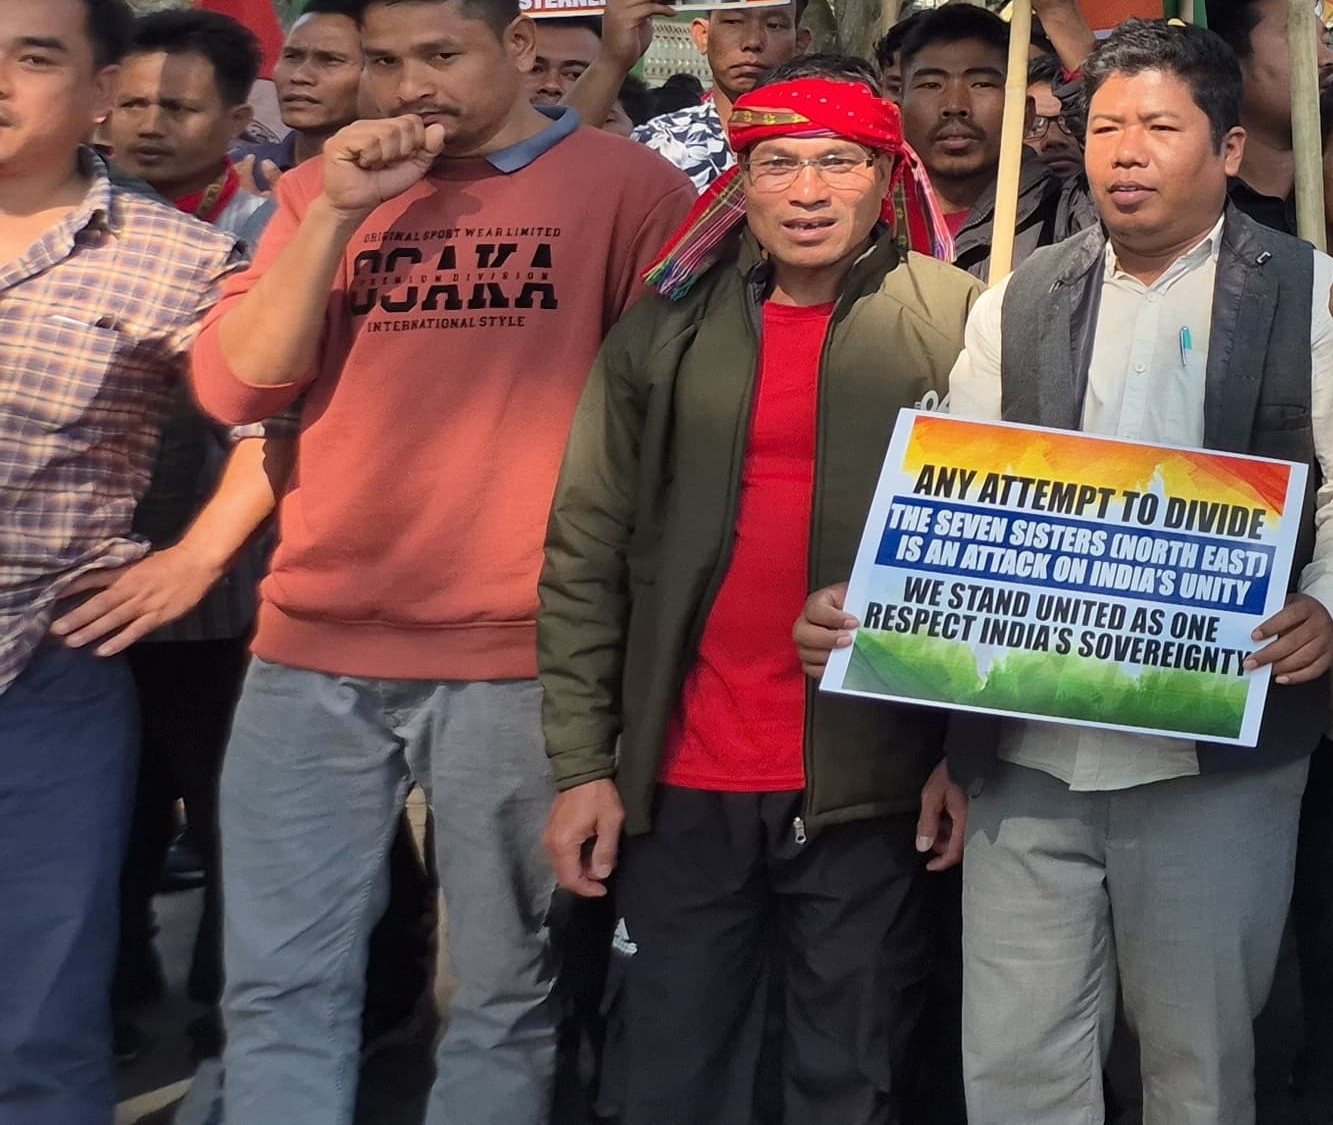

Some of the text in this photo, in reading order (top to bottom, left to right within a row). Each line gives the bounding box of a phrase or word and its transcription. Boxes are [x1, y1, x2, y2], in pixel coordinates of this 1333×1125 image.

[423, 229, 460, 240] SPORT
[465, 227, 502, 238] WEAR
[507, 227, 560, 237] LIMITED
[351, 243, 558, 315] OSAKA
[368, 316, 525, 332] INTERNATIONAL STYLE
[914, 464, 1266, 540] ANY ATTEMPT TO DIVIDE
[888, 504, 1266, 577] THE SEVEN SISTERS (NORTH EAST)
[896, 536, 1250, 605] IS AN ATTACK ON INDIA'S UNITY
[864, 602, 1252, 677] RESPECT INDIA'S SOVEREIGNTY
[903, 577, 1220, 643] WE STAND UNITED AS ONE
